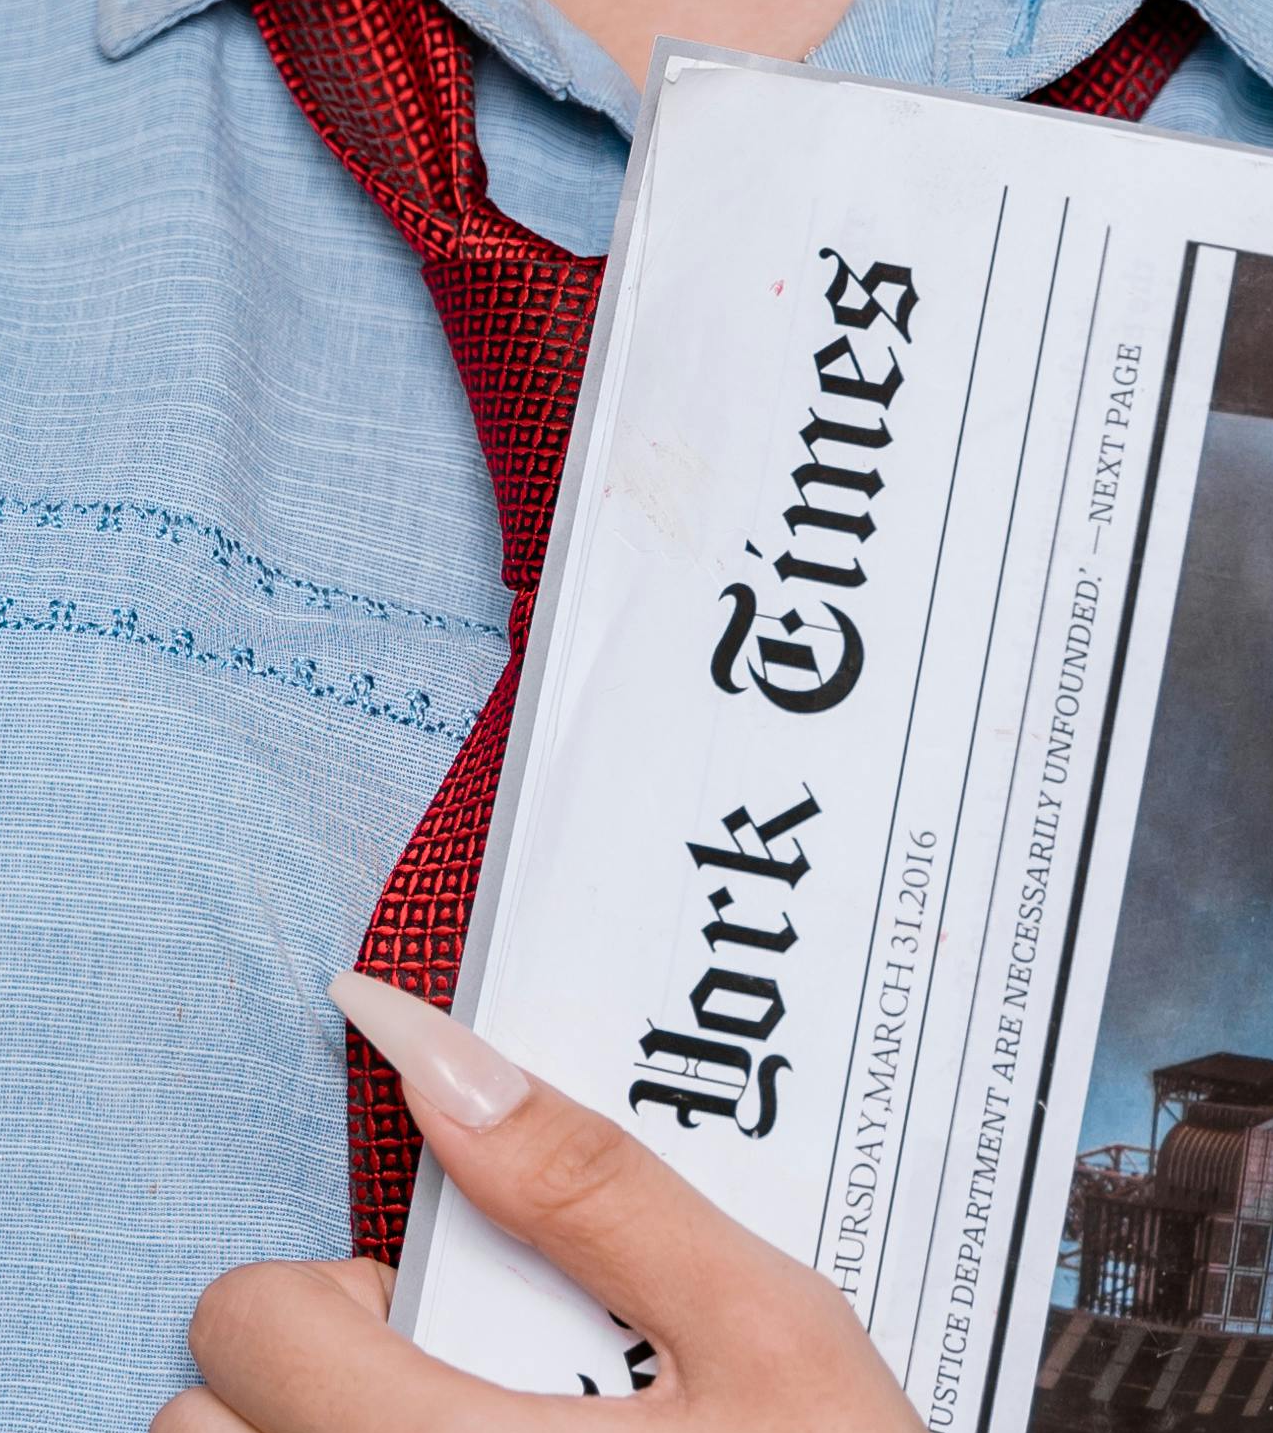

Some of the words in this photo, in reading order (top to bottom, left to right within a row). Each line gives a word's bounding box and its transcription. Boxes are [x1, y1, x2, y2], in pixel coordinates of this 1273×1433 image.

[710, 245, 920, 714] Times
[1104, 341, 1143, 428] PAGE
[627, 780, 823, 1138] York
[1002, 788, 1062, 1010] NECESSARILY
[833, 960, 914, 1309] HURSDAY,MARCH
[990, 1013, 1023, 1082] ARE
[950, 1085, 1011, 1308] DEPARTMENT
